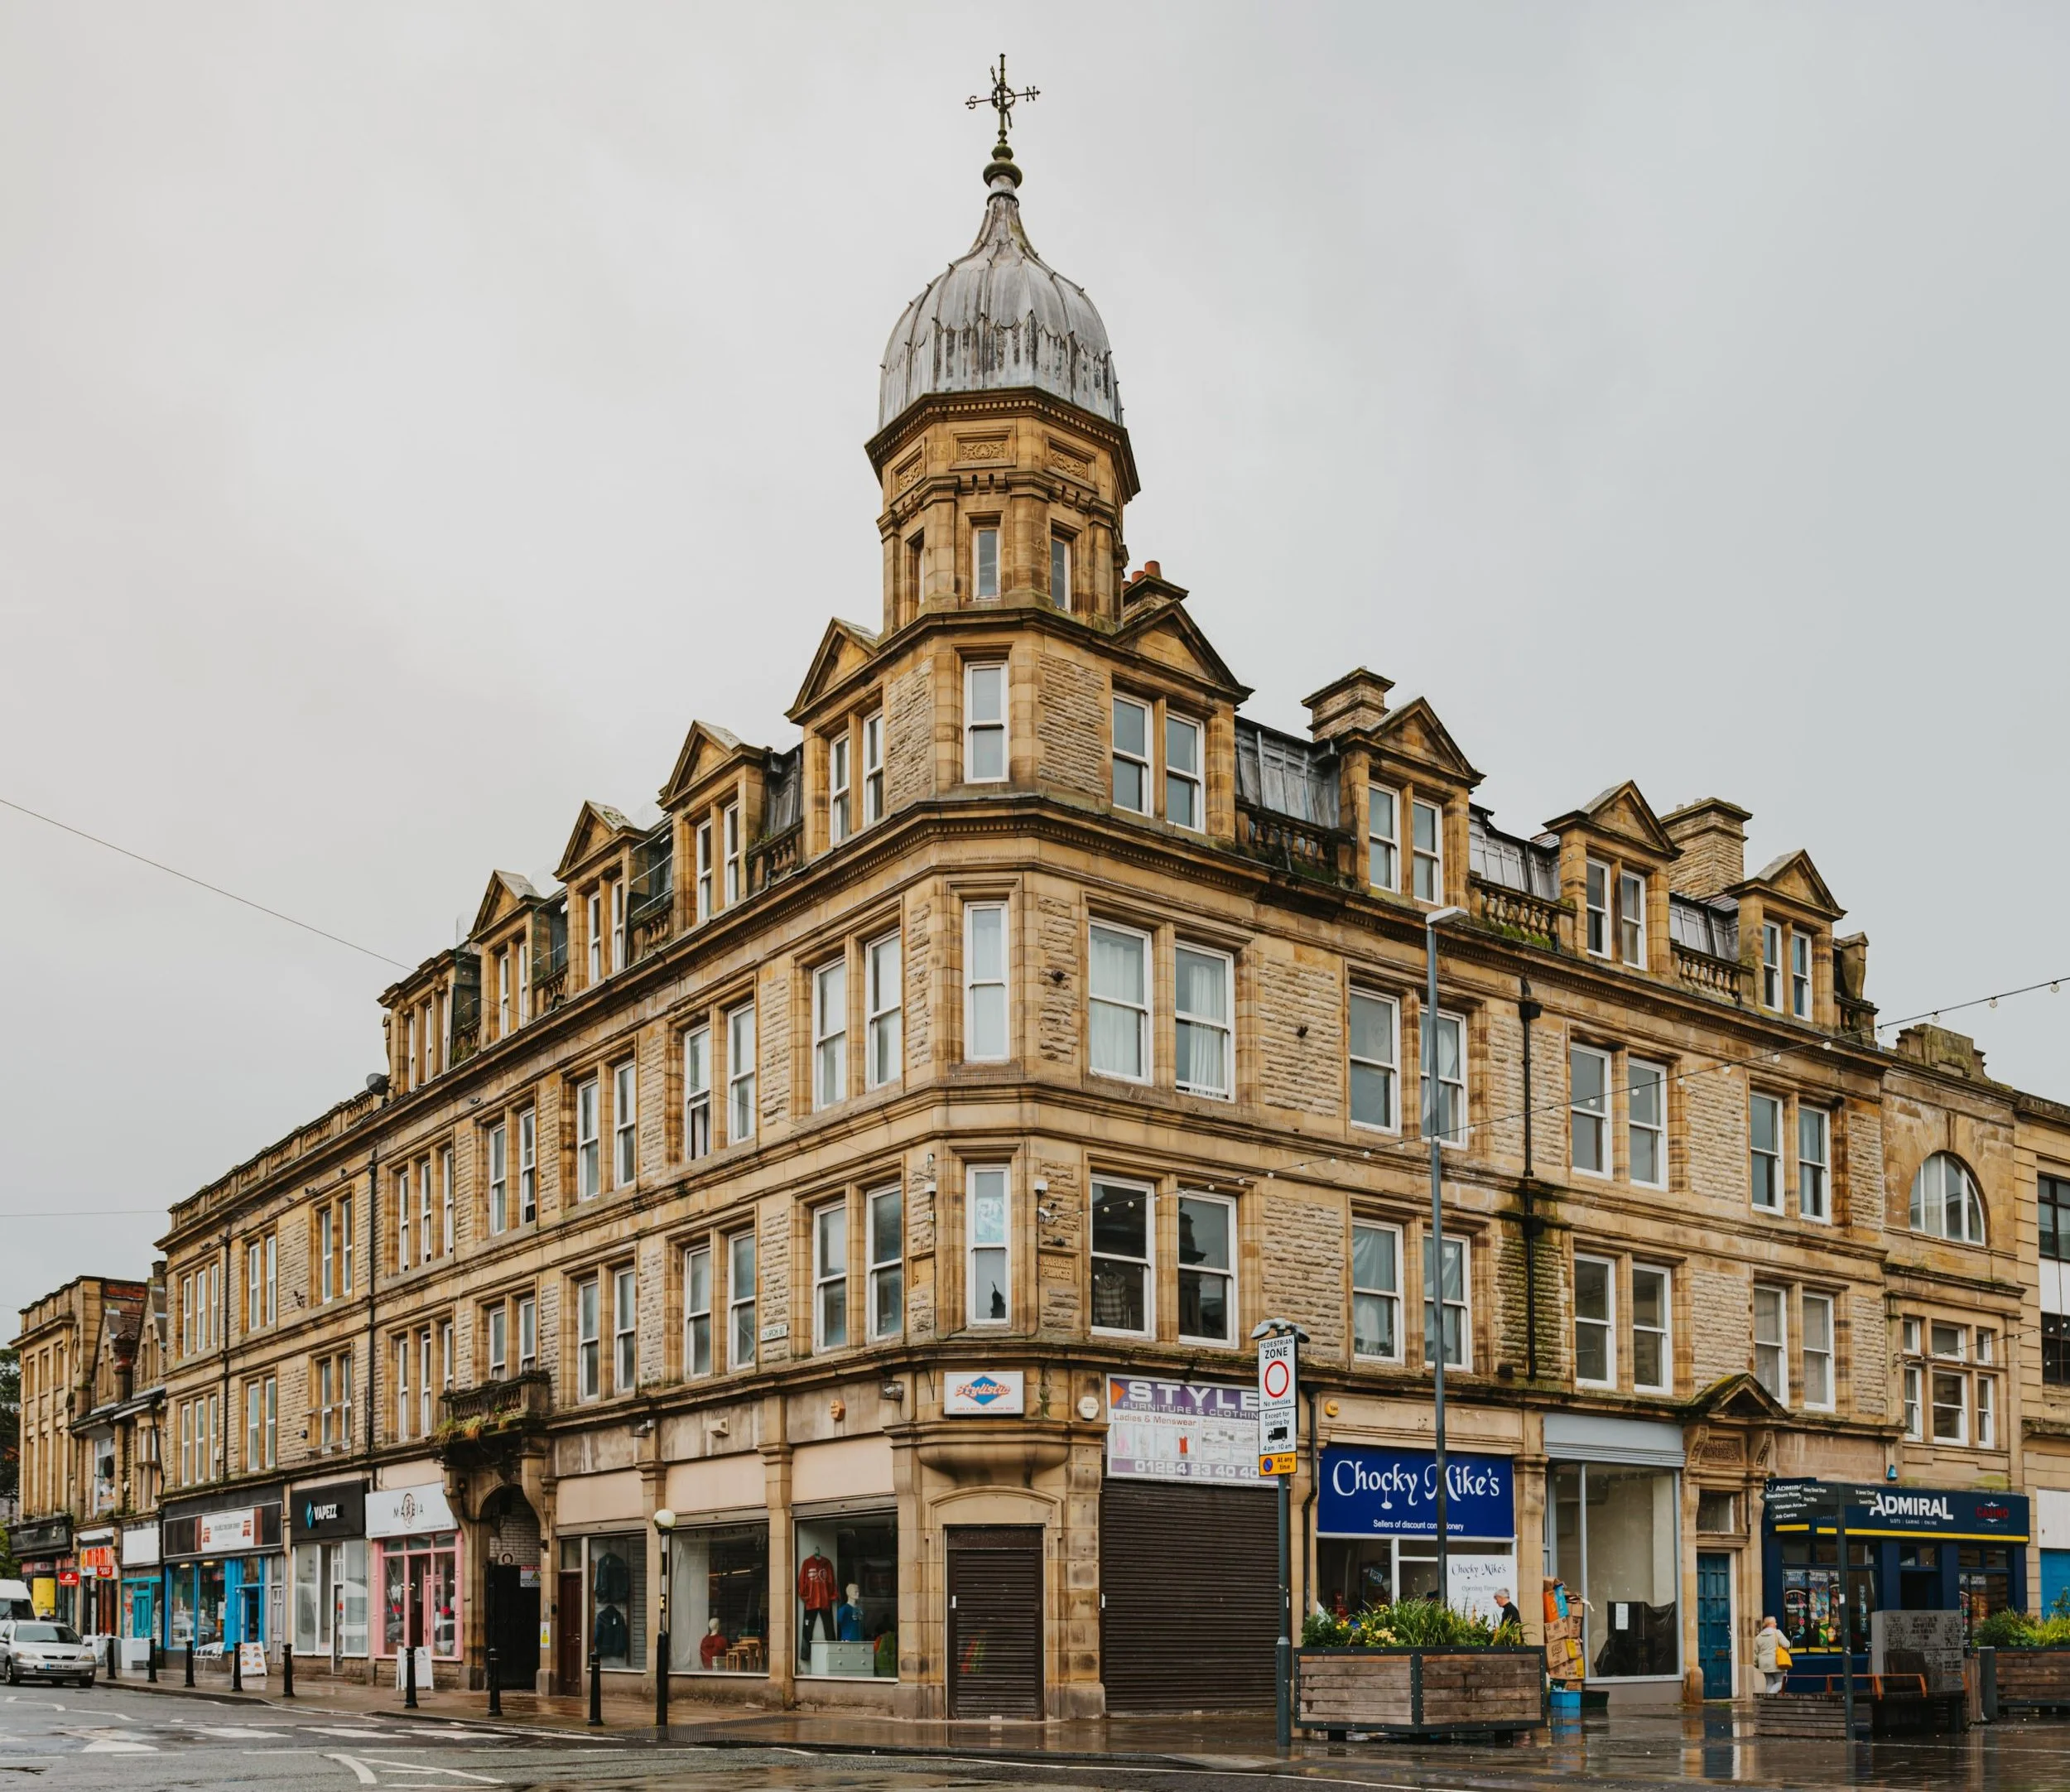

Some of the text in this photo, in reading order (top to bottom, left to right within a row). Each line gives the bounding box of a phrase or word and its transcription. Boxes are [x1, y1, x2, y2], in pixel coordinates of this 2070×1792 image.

[1260, 1338, 1293, 1348] PEDESTRIAN
[1265, 1347, 1288, 1359] ZONE
[1123, 1401, 1259, 1419] FURNITURE & CLOTHIN
[1114, 1412, 1196, 1426] Ladies & Menswear
[1134, 1461, 1259, 1479] 01254 23 40 40
[1333, 1460, 1418, 1509] Chocky
[314, 1504, 337, 1520] VAPEZZ
[1869, 1493, 1954, 1520] ADMIRAL
[1976, 1507, 2010, 1519] CASINO
[1373, 1519, 1464, 1531] Sellers of discount conionery
[1451, 1563, 1507, 1579] Chocky Mike's
